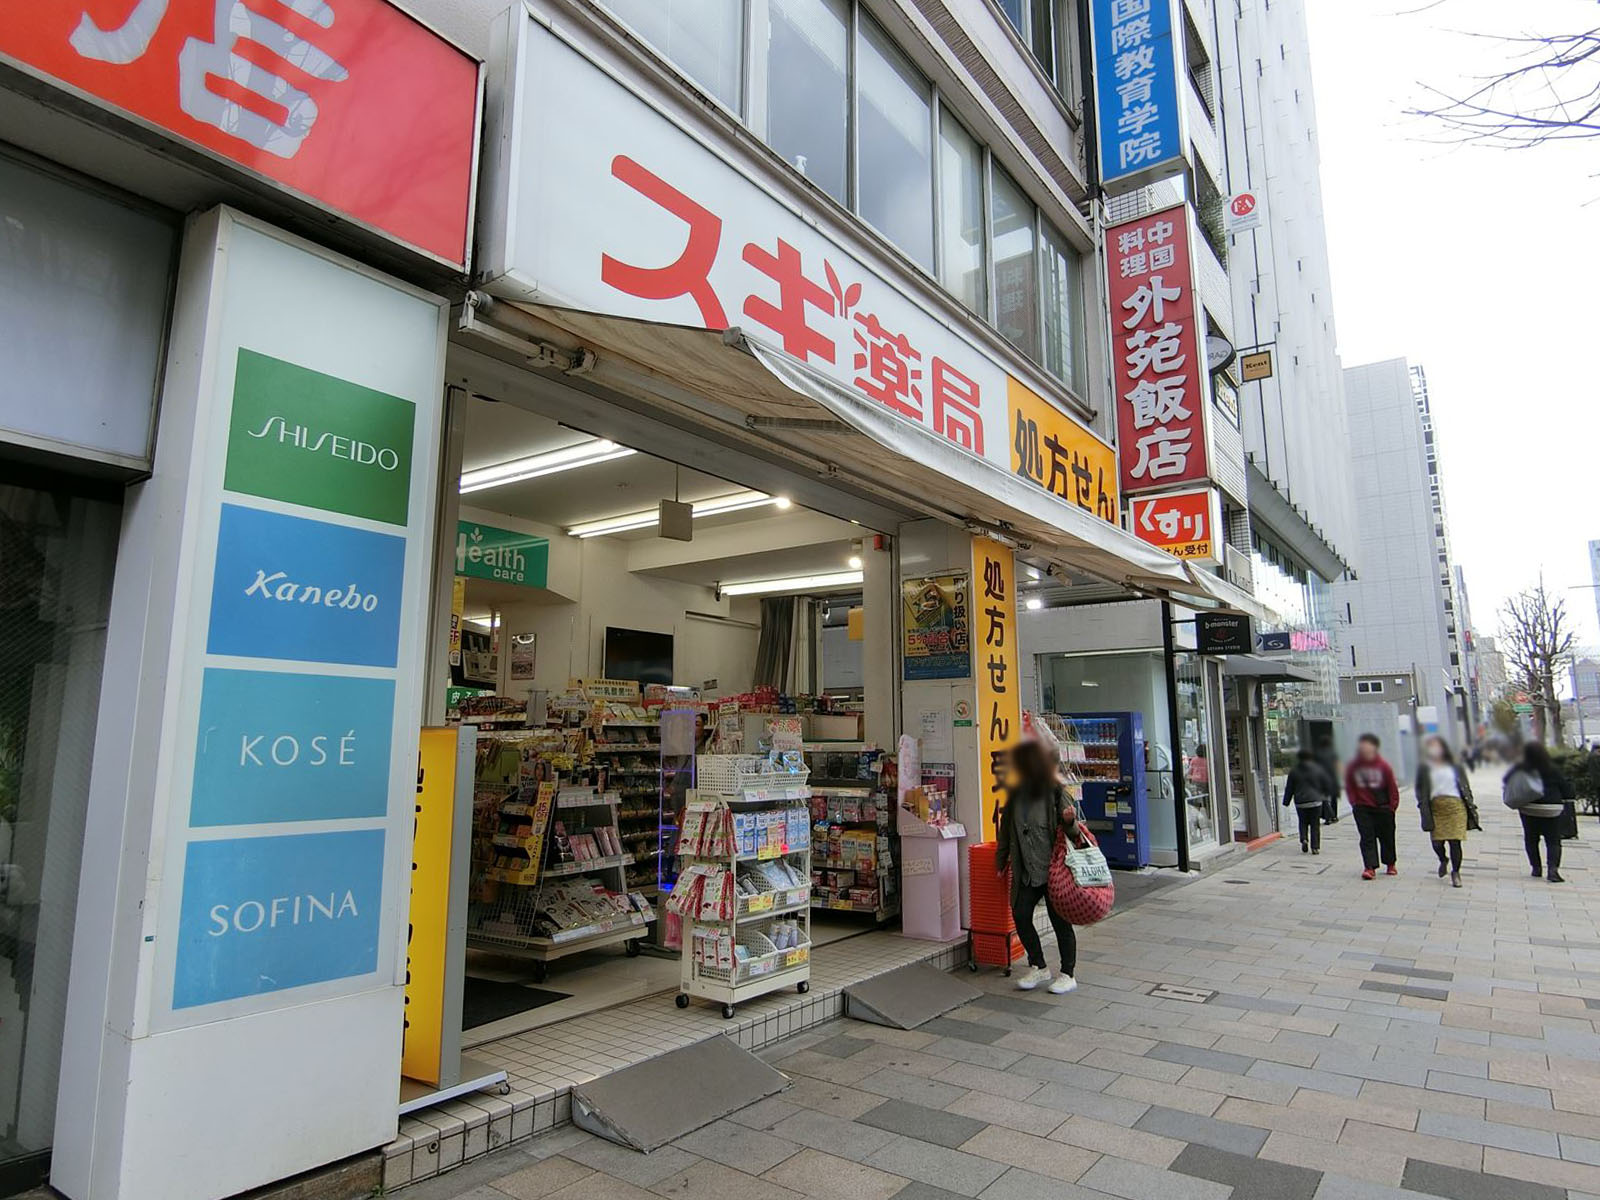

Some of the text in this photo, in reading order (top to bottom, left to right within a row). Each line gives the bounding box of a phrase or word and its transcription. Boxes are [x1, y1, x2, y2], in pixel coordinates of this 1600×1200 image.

[1111, 0, 1161, 169] 国際教育学院
[1117, 227, 1146, 279] 料理
[1148, 220, 1175, 272] 中国
[601, 154, 985, 457] スギ薬局
[1121, 275, 1192, 480] 外苑飯店
[247, 415, 399, 471] SHISEIDO
[1015, 407, 1115, 525] 処方せん
[1139, 499, 1204, 541] くすり
[245, 567, 379, 613] Kanebo
[493, 568, 525, 582] care
[239, 729, 357, 768] KOSÉ
[1080, 865, 1107, 877] ALOHA
[207, 888, 359, 937] SOFINA
